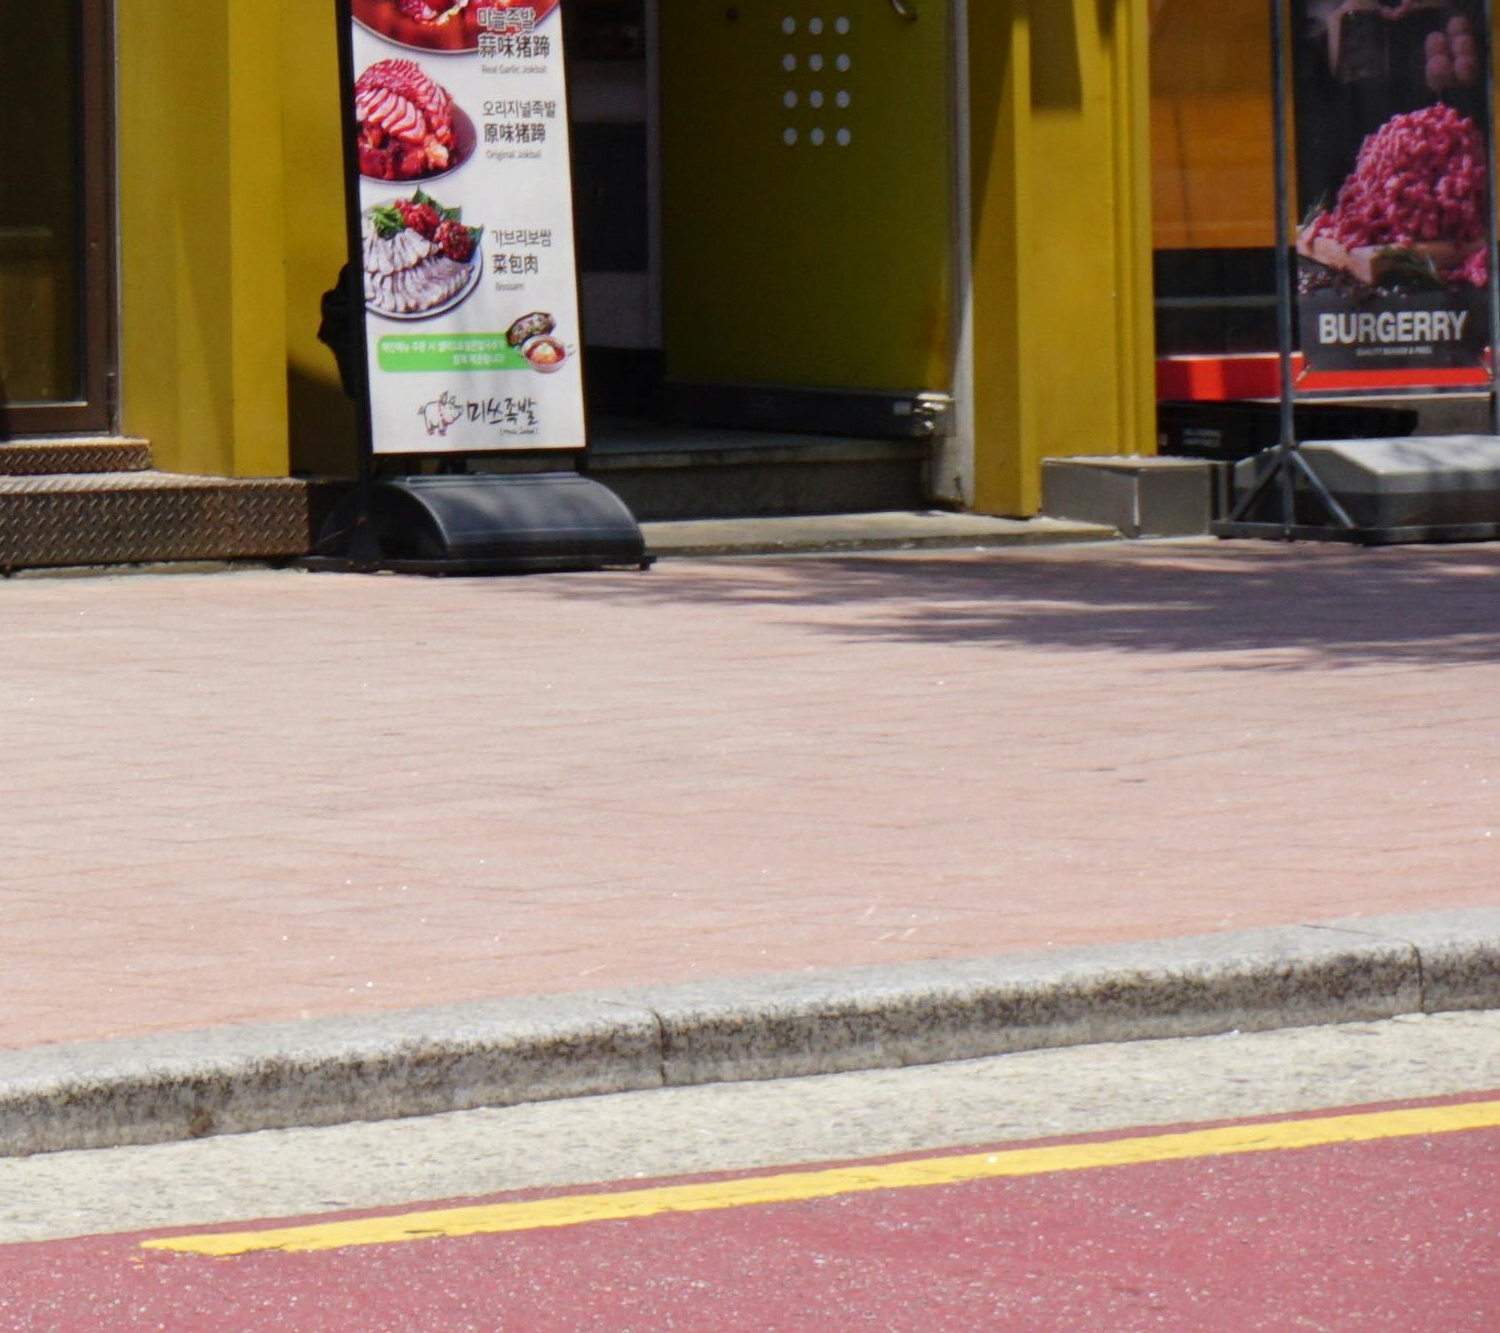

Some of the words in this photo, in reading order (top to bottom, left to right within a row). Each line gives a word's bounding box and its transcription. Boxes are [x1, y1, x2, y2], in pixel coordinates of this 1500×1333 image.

[477, 7, 536, 32] 마늘족발
[479, 35, 550, 58] 蒜味猪蹄
[482, 99, 556, 119] 오리지널족발
[484, 123, 546, 144] 原味猪蹄
[492, 229, 552, 248] 가브리보쌈
[492, 253, 539, 275] 菜包肉
[1319, 310, 1467, 344] BURGERRY
[467, 397, 538, 425] 미쓰족발
